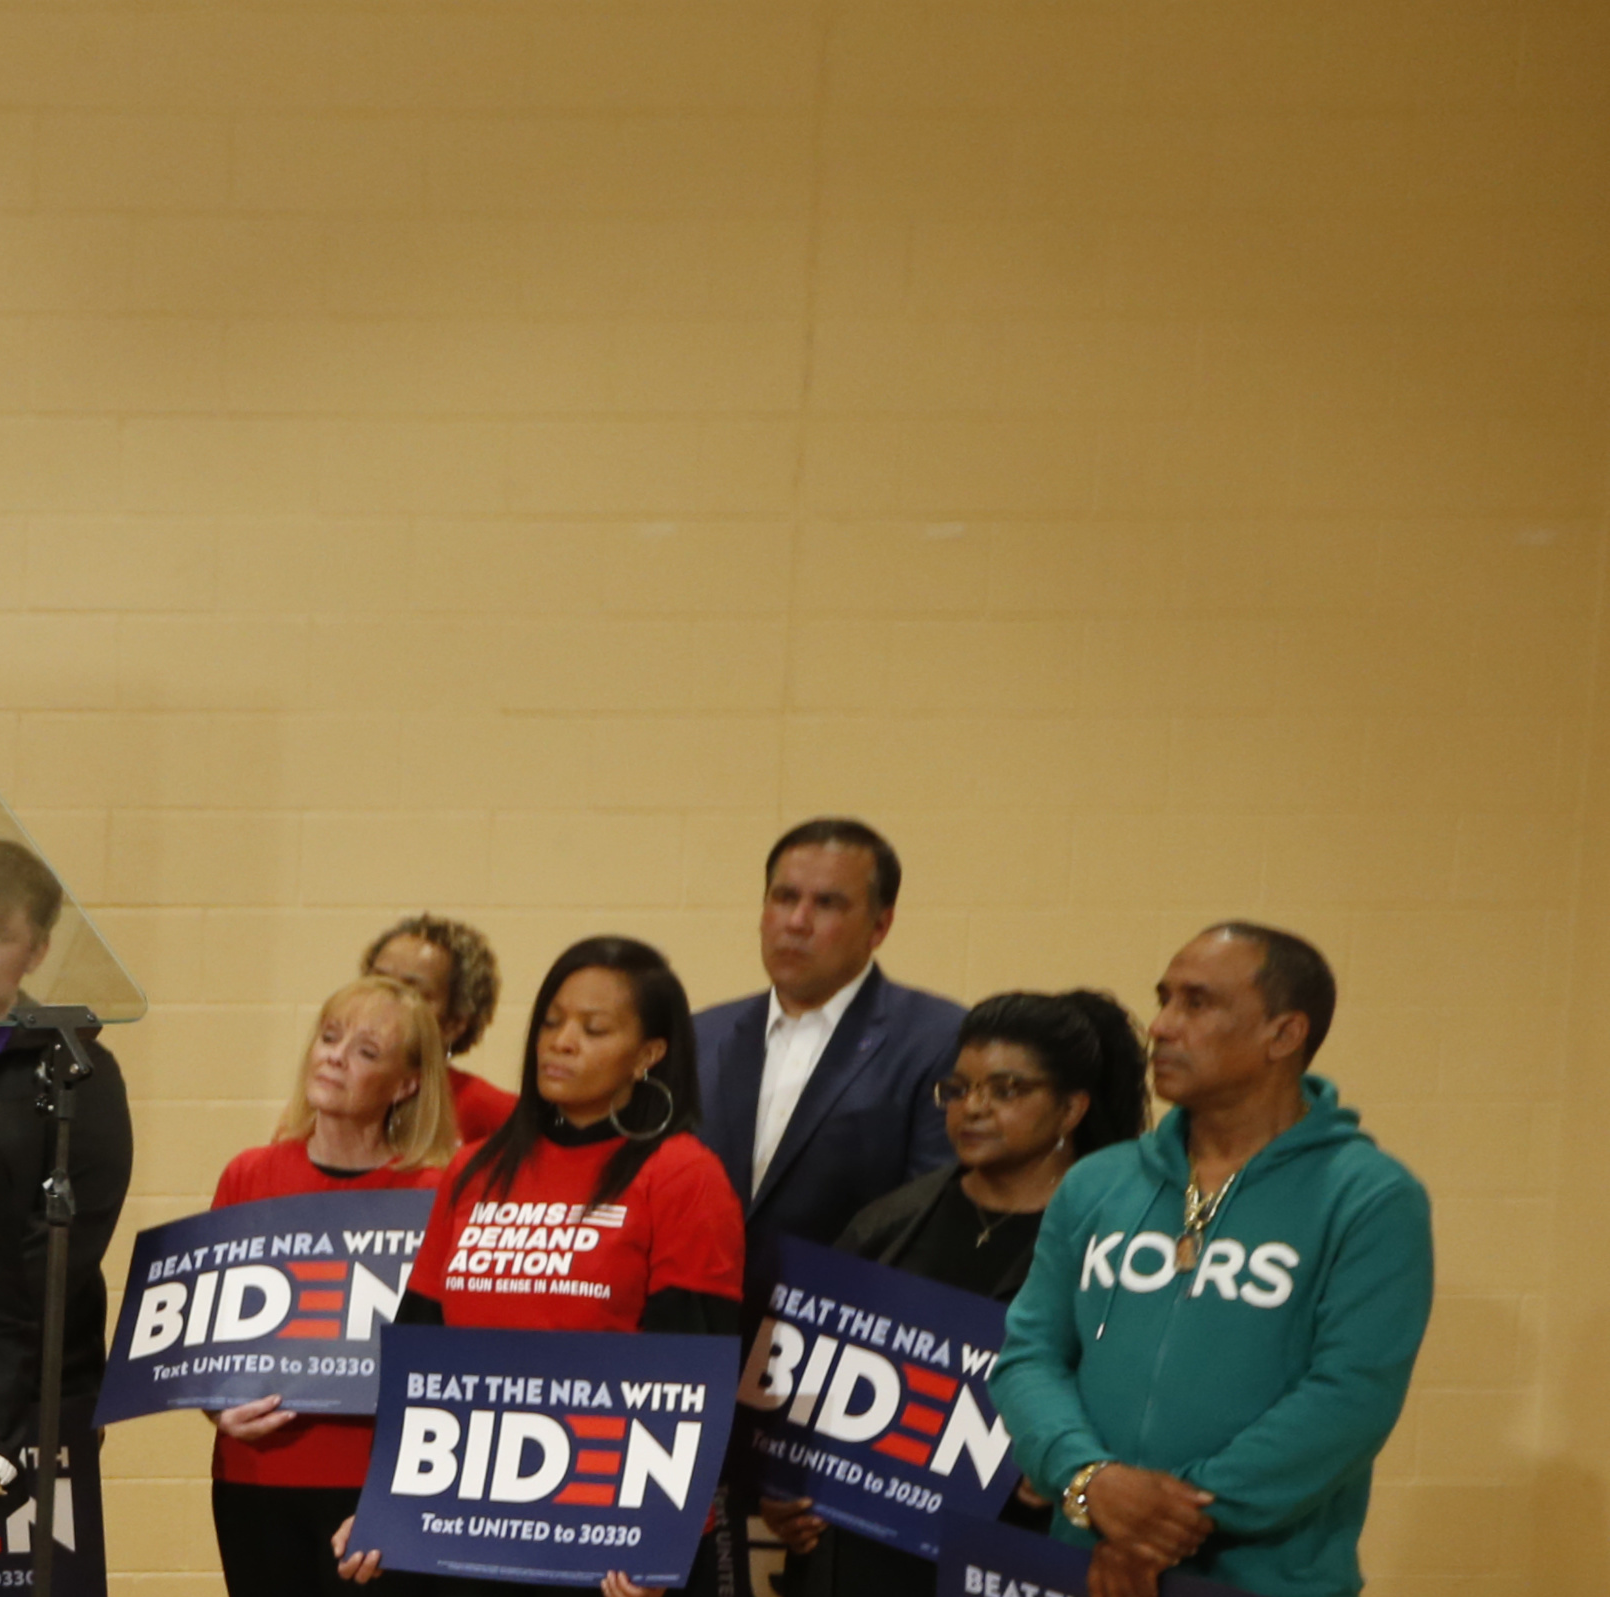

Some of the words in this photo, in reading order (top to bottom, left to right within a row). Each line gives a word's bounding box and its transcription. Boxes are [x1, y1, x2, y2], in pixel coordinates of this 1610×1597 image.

[469, 1201, 568, 1226] MOMS
[147, 1248, 208, 1283] BEAT
[214, 1236, 266, 1265] THE
[270, 1233, 334, 1257] NRA
[342, 1230, 425, 1255] WITH
[457, 1226, 600, 1252] DEMAND
[447, 1249, 573, 1276] ACTION
[445, 1276, 465, 1291] FOR
[468, 1277, 492, 1292] GUN
[495, 1278, 532, 1294] SENSE
[534, 1279, 547, 1294] IN
[549, 1279, 611, 1299] AMERICA
[128, 1261, 413, 1361] BIDEN
[770, 1283, 835, 1326] BEAT
[836, 1303, 892, 1347] THE
[892, 1323, 950, 1368] NRA
[962, 1343, 1000, 1382] WI
[153, 1361, 188, 1381] Text
[193, 1355, 276, 1375] UNITED
[280, 1357, 302, 1374] to
[307, 1357, 376, 1376] 30330
[407, 1372, 479, 1401] BEAT
[485, 1376, 543, 1405] THE
[549, 1379, 613, 1408] NRA
[620, 1381, 706, 1413] WITH
[737, 1315, 1012, 1491] BIDEN
[390, 1406, 702, 1511] BIDEN
[752, 1429, 787, 1459] Text
[789, 1442, 864, 1486] UNITED
[864, 1470, 884, 1495] to
[884, 1477, 942, 1514] 30330
[421, 1512, 464, 1535] Text
[468, 1516, 550, 1542] UNITED
[554, 1525, 575, 1543] to
[578, 1523, 642, 1547] 30330
